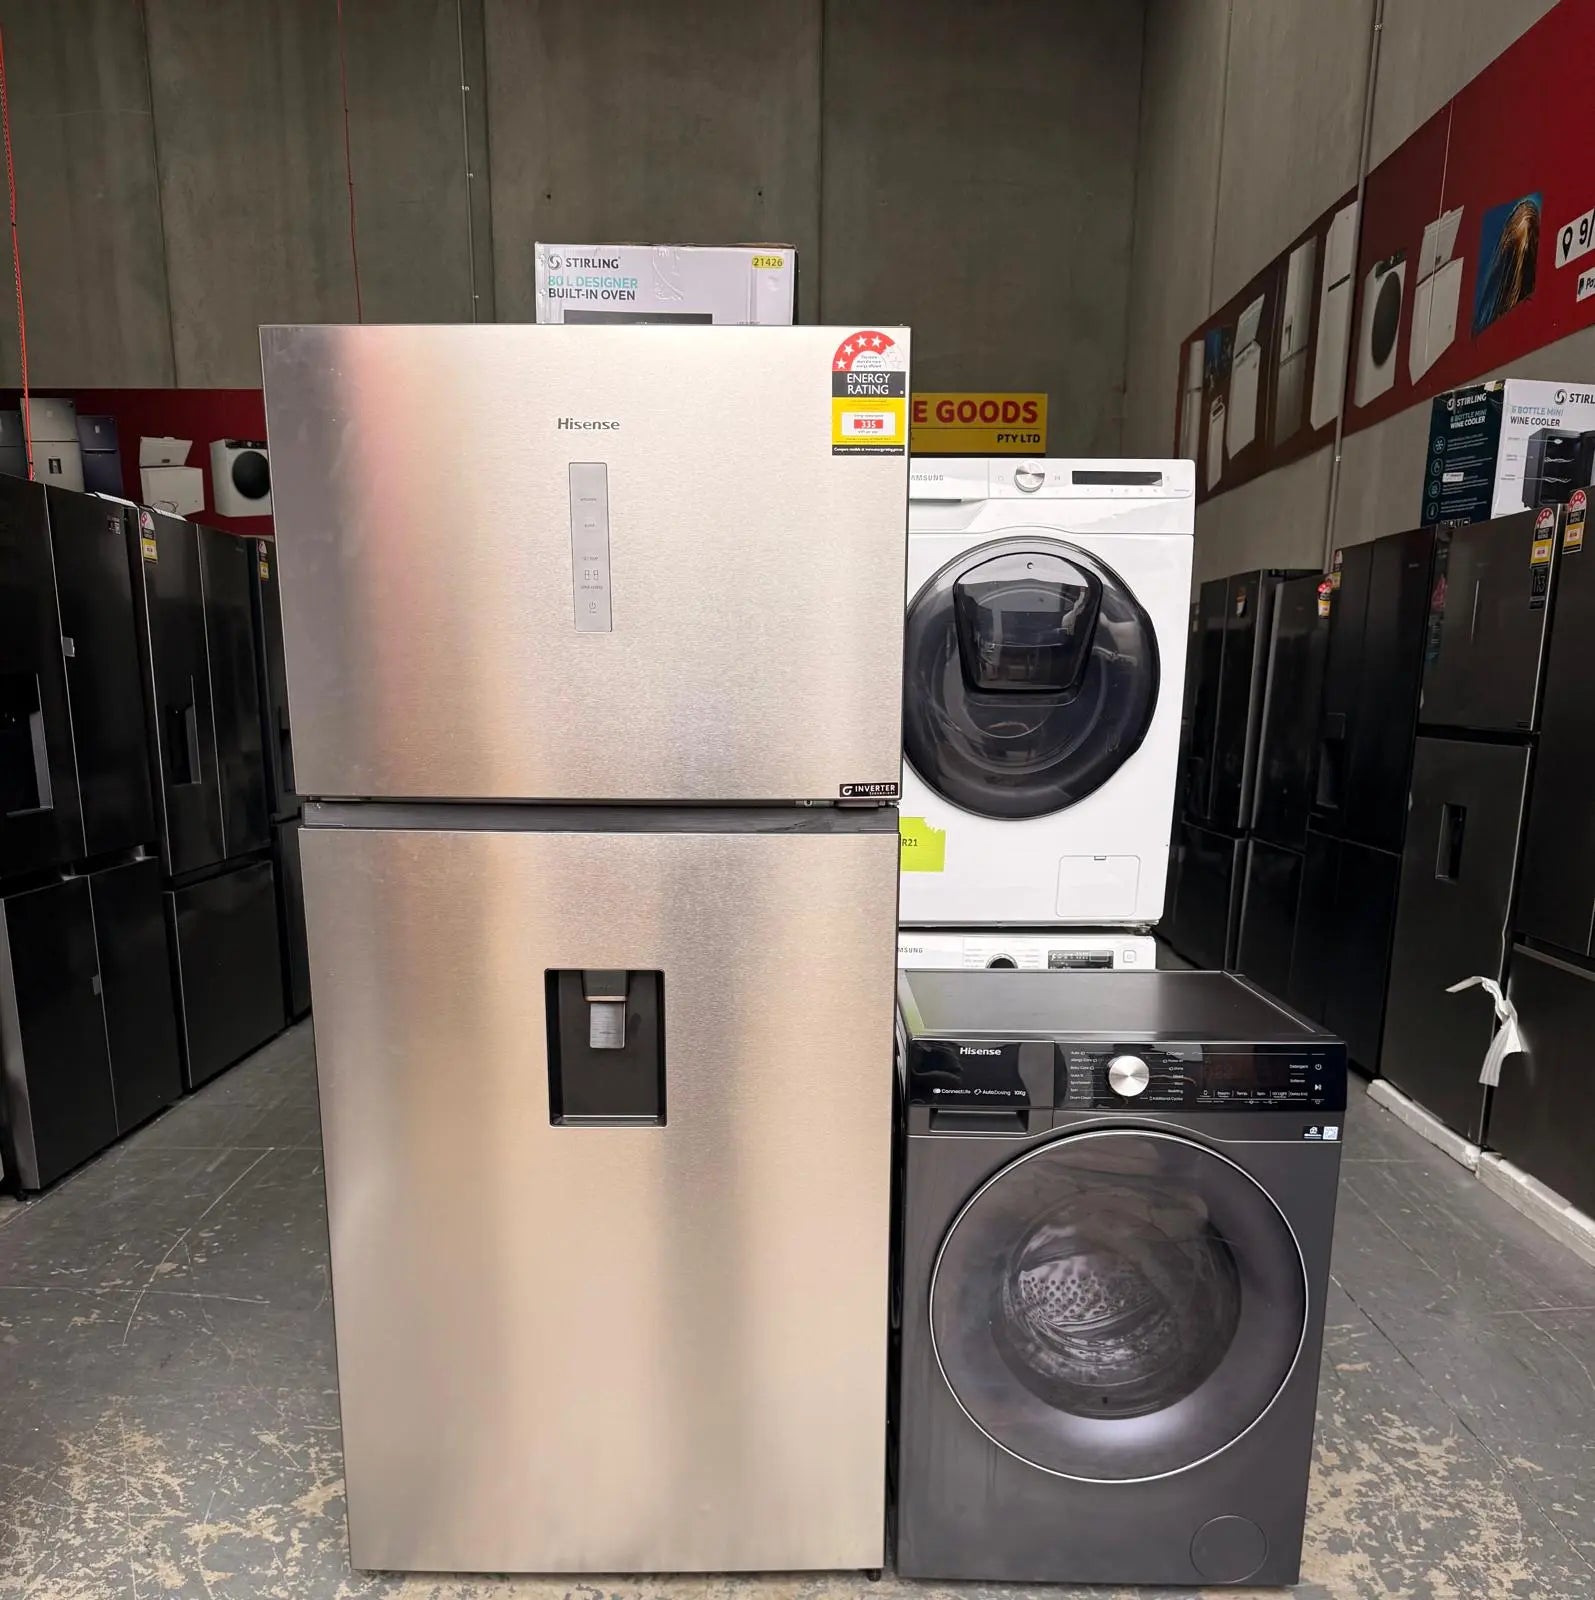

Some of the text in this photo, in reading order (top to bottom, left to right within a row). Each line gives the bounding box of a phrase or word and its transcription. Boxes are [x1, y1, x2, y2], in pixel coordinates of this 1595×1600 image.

[565, 257, 619, 269] STIRLING
[752, 257, 783, 267] 21426
[548, 275, 564, 287] 80
[577, 276, 638, 289] DESIGNER
[548, 288, 636, 301] BUILT-IN OVEN
[846, 373, 890, 384] ENERGY
[847, 384, 889, 395] RATING
[1456, 393, 1487, 407] STIRLING
[1569, 393, 1595, 404] STIRL
[913, 400, 928, 423] E
[935, 400, 1039, 424] GOODS
[1518, 406, 1546, 415] BOTTLE
[1546, 408, 1564, 417] MINI
[557, 417, 620, 430] Hisense
[860, 420, 877, 428] 335
[1450, 415, 1486, 430] WINE COOLER
[1510, 416, 1561, 427] WINE COOLER
[997, 434, 1041, 444] PTY LTD
[854, 784, 896, 793] INVERTER
[901, 838, 918, 847] R21
[959, 1047, 1002, 1056] Hisense
